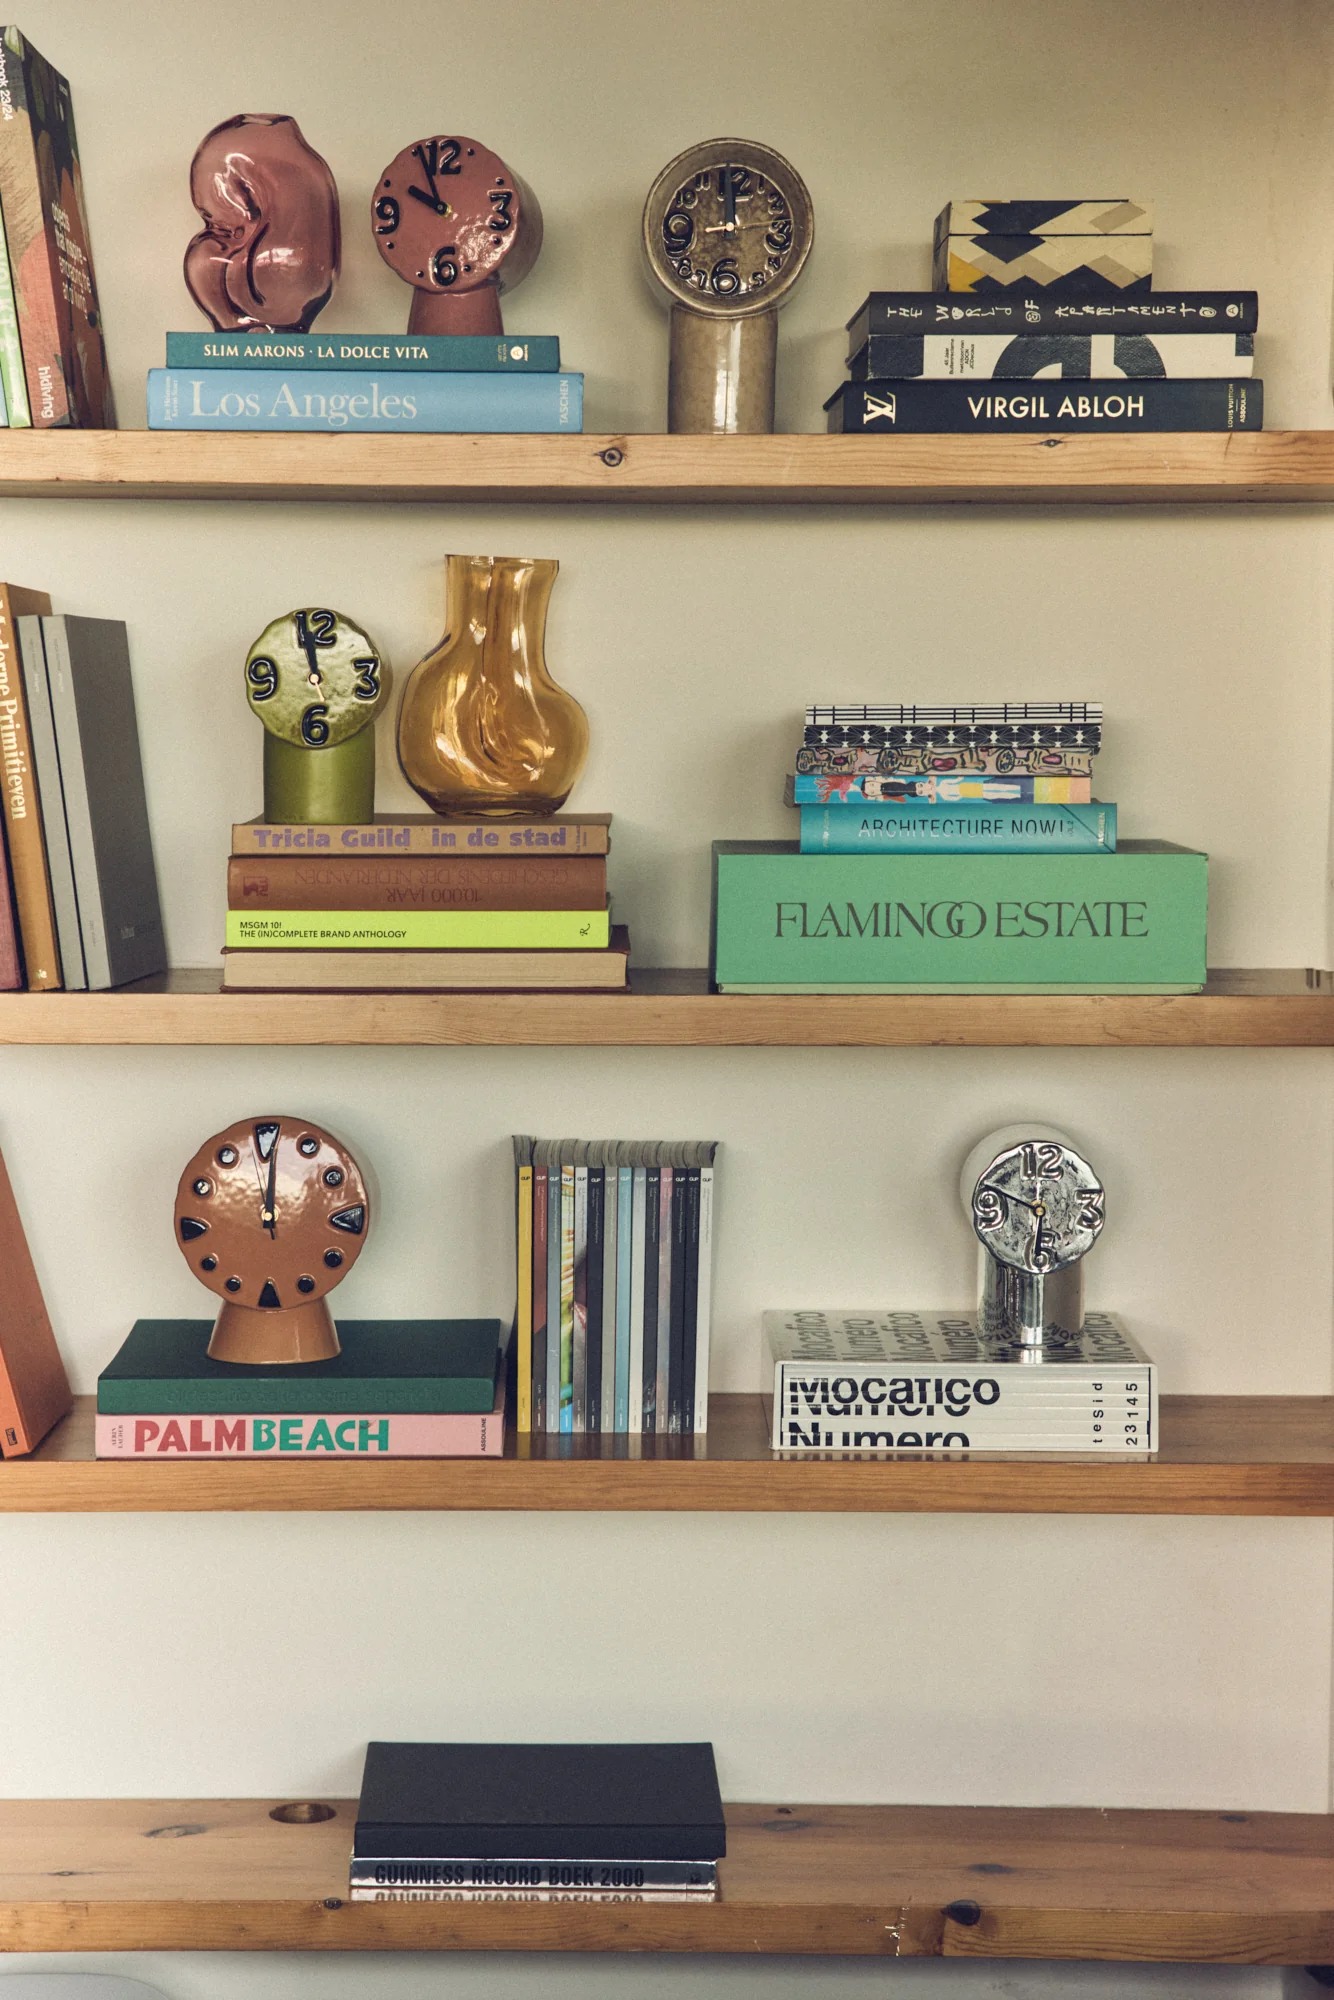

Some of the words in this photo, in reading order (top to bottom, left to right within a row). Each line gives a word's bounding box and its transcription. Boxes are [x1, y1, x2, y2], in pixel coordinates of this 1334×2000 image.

[426, 138, 461, 176] 12
[375, 196, 399, 234] 9
[487, 189, 512, 231] 3
[663, 212, 696, 257] 9
[431, 246, 457, 286] 6
[710, 258, 741, 295] 6
[887, 307, 922, 318] THE
[204, 344, 239, 357] SLIM
[244, 345, 305, 358] AARONS
[318, 346, 335, 358] LA
[340, 346, 390, 358] DOLCE
[396, 346, 429, 359] VITA
[38, 366, 54, 419] hkliving
[190, 380, 260, 418] Los
[268, 383, 417, 426] Angeles
[559, 379, 569, 425] TASCHEN
[967, 396, 1049, 418] VIRGIL
[1057, 396, 1144, 418] ABLOH
[295, 610, 337, 649] 12
[248, 657, 278, 700] 9
[353, 657, 380, 700] 3
[301, 704, 330, 746] 6
[0, 697, 27, 820] Primitieven
[253, 829, 331, 848] Tricia
[341, 827, 411, 848] Guild
[431, 827, 457, 847] in
[467, 827, 499, 847] de
[509, 827, 567, 847] stad
[858, 818, 1004, 838] ARCHITECTURE
[1010, 818, 1064, 838] NOW!
[294, 868, 411, 886] NEDERLANDEN
[385, 886, 426, 903] JAAR
[418, 868, 450, 886] DER
[458, 868, 569, 886] GESCHIEDENIS
[239, 921, 267, 929] MSGM
[270, 921, 282, 929] 10!
[239, 930, 256, 938] THE
[257, 930, 319, 938] (IN)COMPLETE
[320, 930, 351, 938] BRAND
[353, 930, 407, 939] ANTHOLOGY
[774, 900, 988, 938] FLAMINGO
[994, 900, 1150, 938] ESTATE
[1019, 1144, 1063, 1181] 12
[974, 1190, 1008, 1231] 9
[1075, 1189, 1104, 1231] 3
[1024, 1230, 1061, 1272] 6
[134, 1419, 246, 1453] PALM
[252, 1418, 390, 1452] BEACH
[375, 1864, 464, 1886] GUINNESS
[472, 1865, 541, 1886] RECORD
[549, 1866, 594, 1887] BOEK
[601, 1867, 645, 1888] 2000
